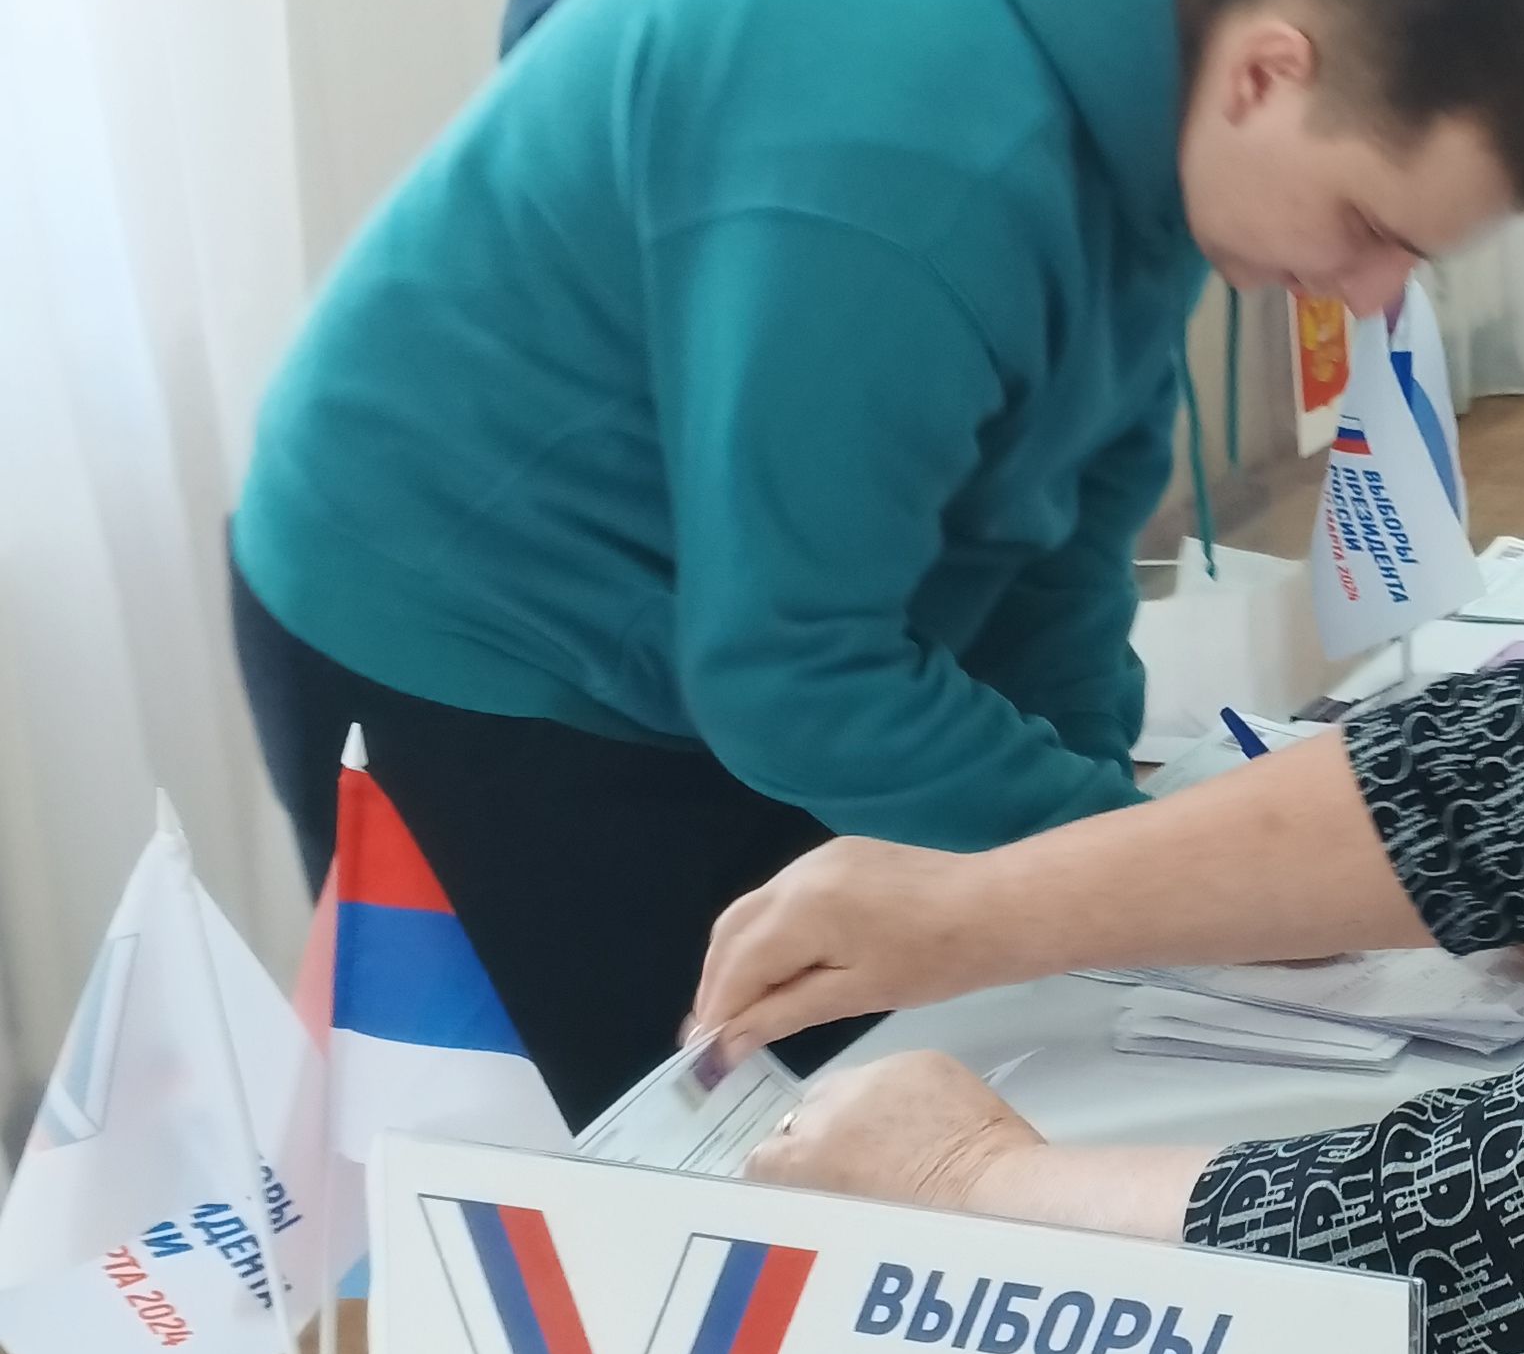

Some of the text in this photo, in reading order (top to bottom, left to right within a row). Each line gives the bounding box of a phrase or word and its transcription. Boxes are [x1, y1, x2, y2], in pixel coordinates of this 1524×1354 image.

[1342, 466, 1410, 603] ПРЕЗИДЕНТА
[1362, 469, 1420, 565] ВЫБОРЫ
[125, 1290, 194, 1346] 2024
